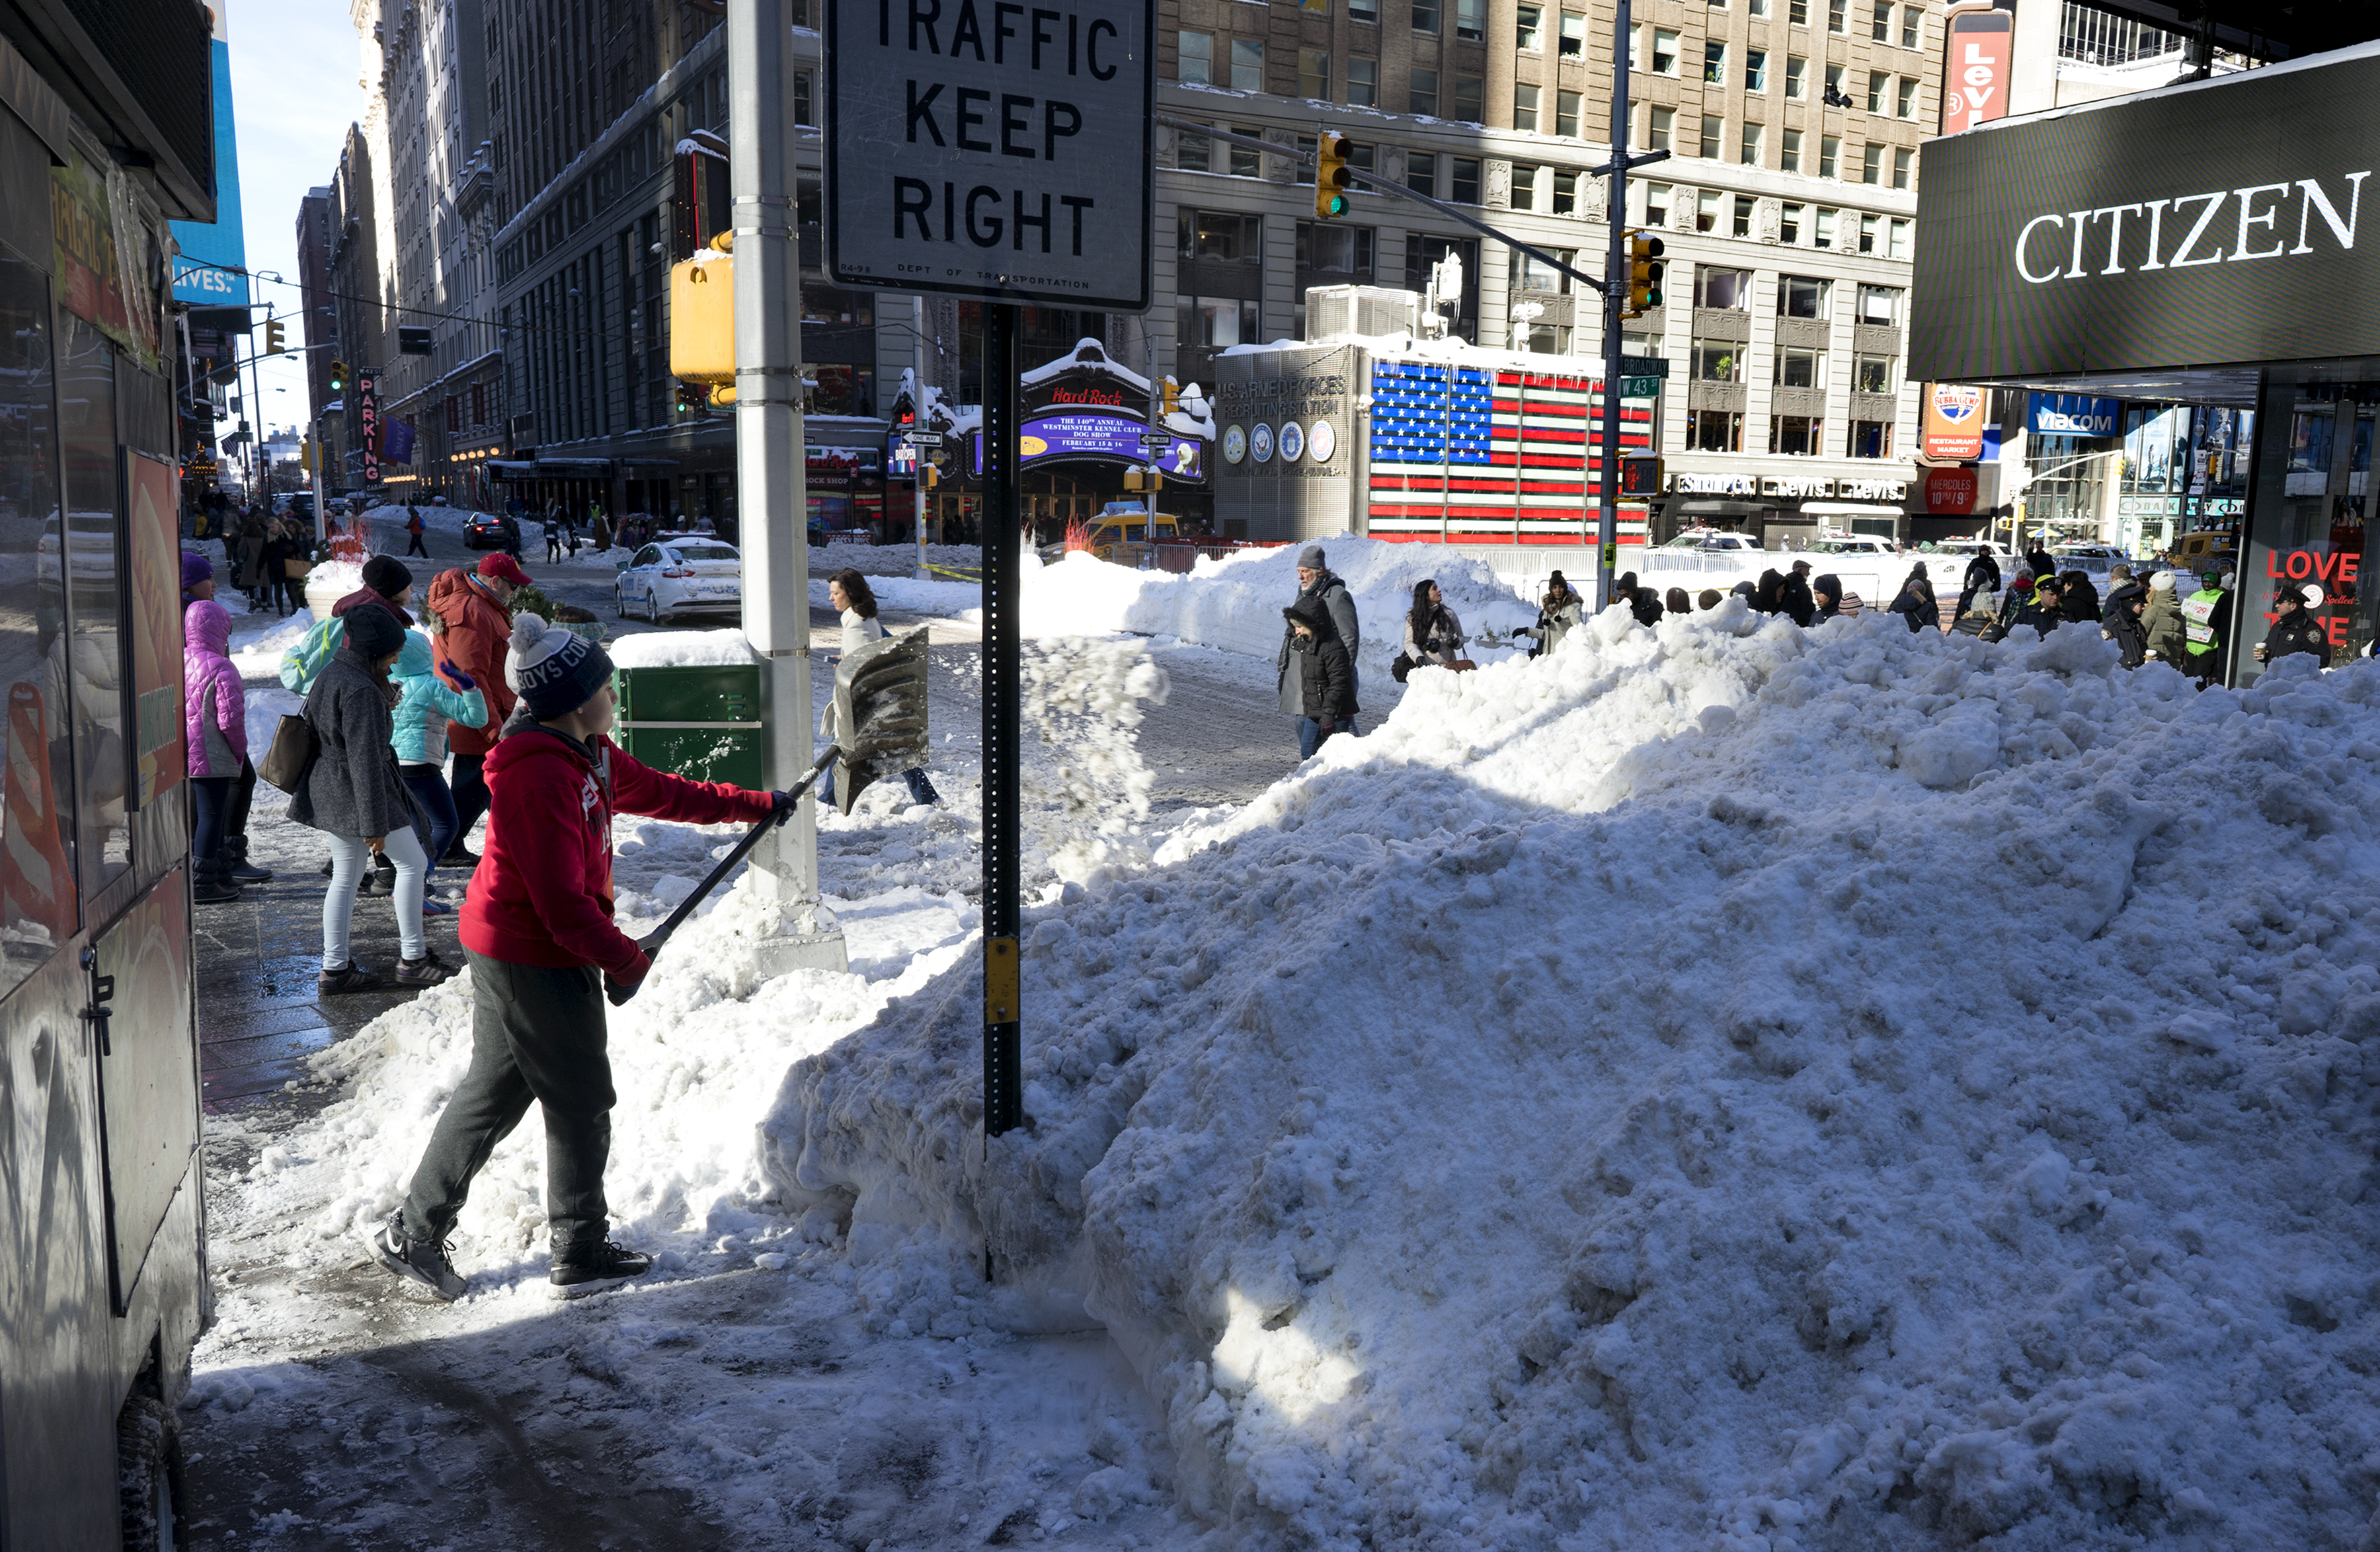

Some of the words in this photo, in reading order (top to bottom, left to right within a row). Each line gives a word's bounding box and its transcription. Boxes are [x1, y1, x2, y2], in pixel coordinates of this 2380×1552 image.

[879, 0, 1118, 81] TRAFFIC
[906, 79, 1082, 161] KEEP
[894, 176, 1094, 256] RIGHT
[2015, 171, 2371, 284] CITIZEN
[898, 264, 931, 274] DEPT
[947, 269, 962, 278] OF
[1624, 358, 1667, 375] BROADWAY
[1241, 379, 1289, 399] ARMED
[1290, 375, 1345, 395] FORCES
[1622, 380, 1630, 395] W
[1634, 379, 1647, 395] 43
[1651, 379, 1657, 387] ST
[1052, 387, 1089, 404] Hard
[1089, 389, 1123, 407] Rock
[1934, 396, 1958, 406] BUBBA
[1959, 395, 1979, 406] GUMP
[1224, 401, 1287, 418] RECRUITING
[1289, 399, 1337, 415] STATION
[360, 379, 379, 480] PARKING
[831, 454, 860, 470] Rock
[895, 449, 904, 461] BAR
[904, 448, 916, 461] OPEN
[1685, 476, 1731, 493] SHRIMP
[1930, 477, 1971, 490] MIÉRCOLES
[2267, 550, 2360, 582] LOVE
[2324, 594, 2355, 606] Spelled
[2264, 612, 2350, 646] TE
[517, 660, 563, 689] BOYS
